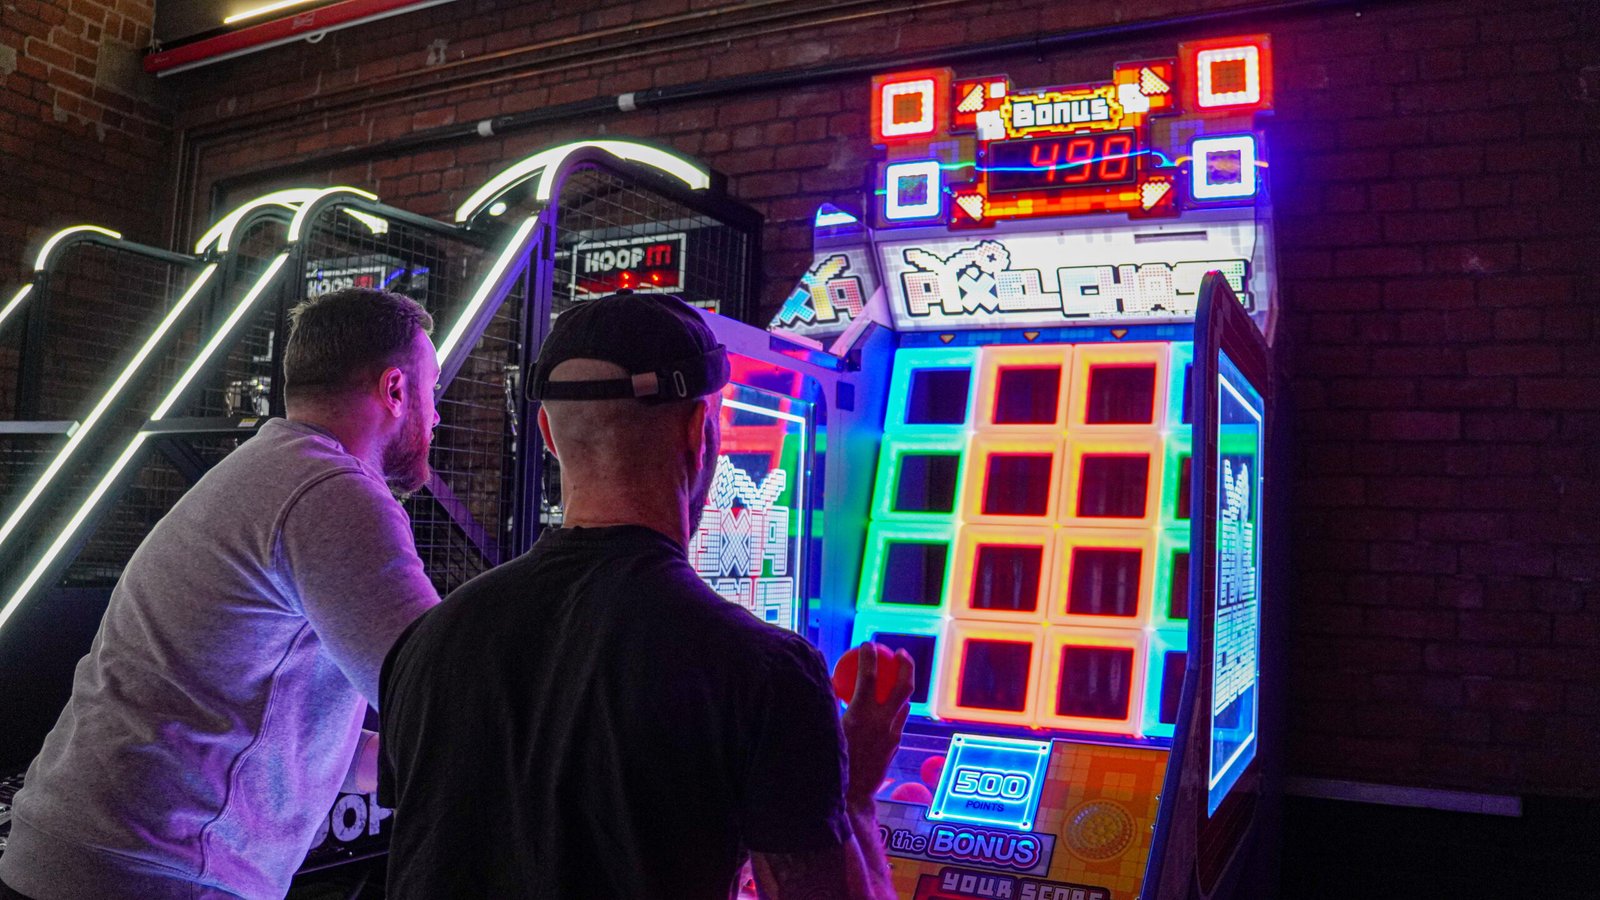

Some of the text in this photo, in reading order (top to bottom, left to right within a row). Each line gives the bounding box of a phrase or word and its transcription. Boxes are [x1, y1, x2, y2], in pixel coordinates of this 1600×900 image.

[584, 247, 645, 273] HOOP
[954, 769, 1028, 799] 500
[965, 799, 1005, 813] POINTS
[892, 831, 925, 851] the
[932, 829, 1036, 864] BONUS
[942, 872, 1013, 898] YOUR
